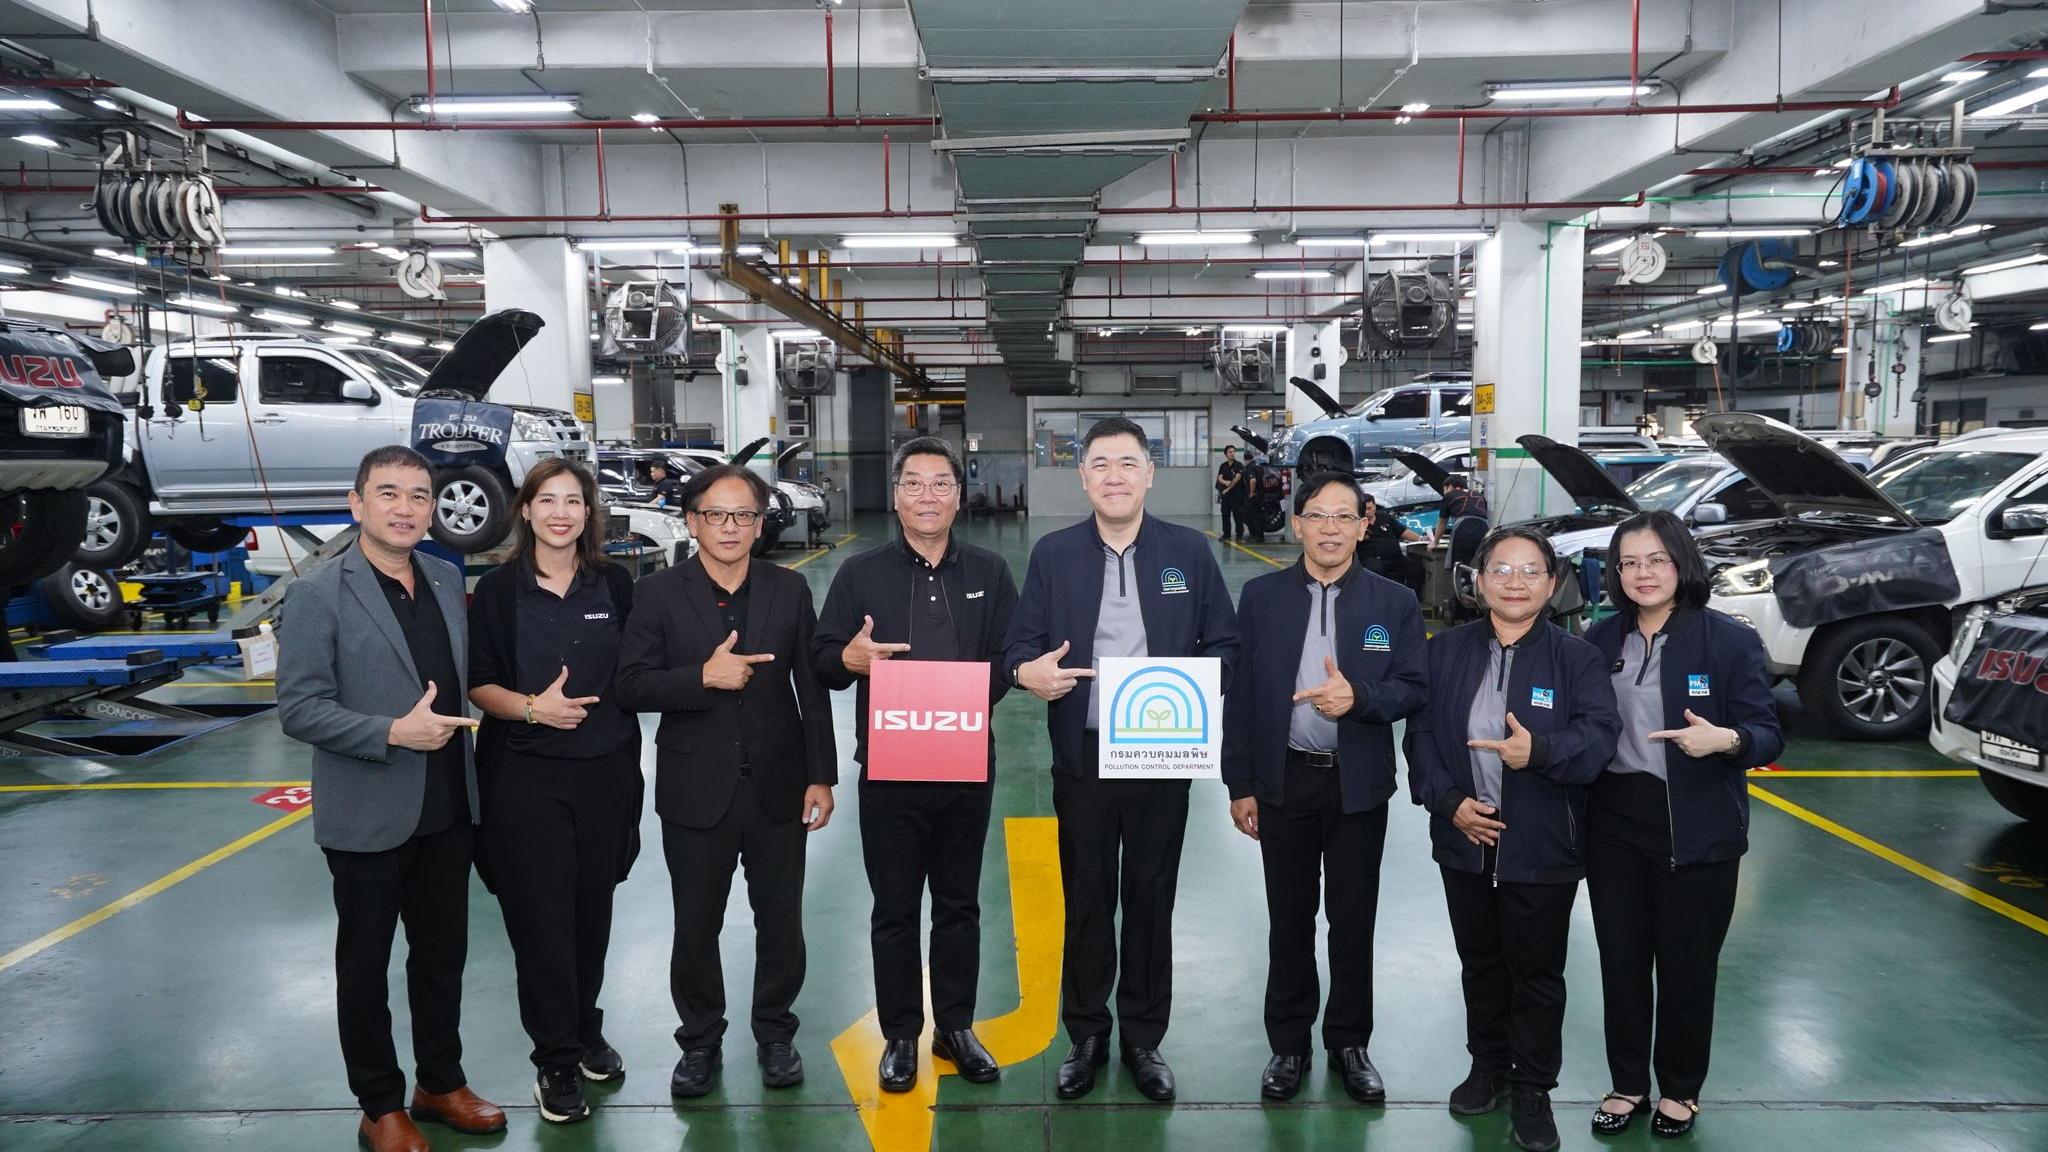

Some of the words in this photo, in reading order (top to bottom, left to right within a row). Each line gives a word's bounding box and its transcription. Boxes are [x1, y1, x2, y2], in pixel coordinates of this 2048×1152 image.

[418, 422, 504, 445] TROOPER
[874, 709, 983, 732] ISUZU
[1110, 747, 1208, 763] กรมควบคุมมลพิษ
